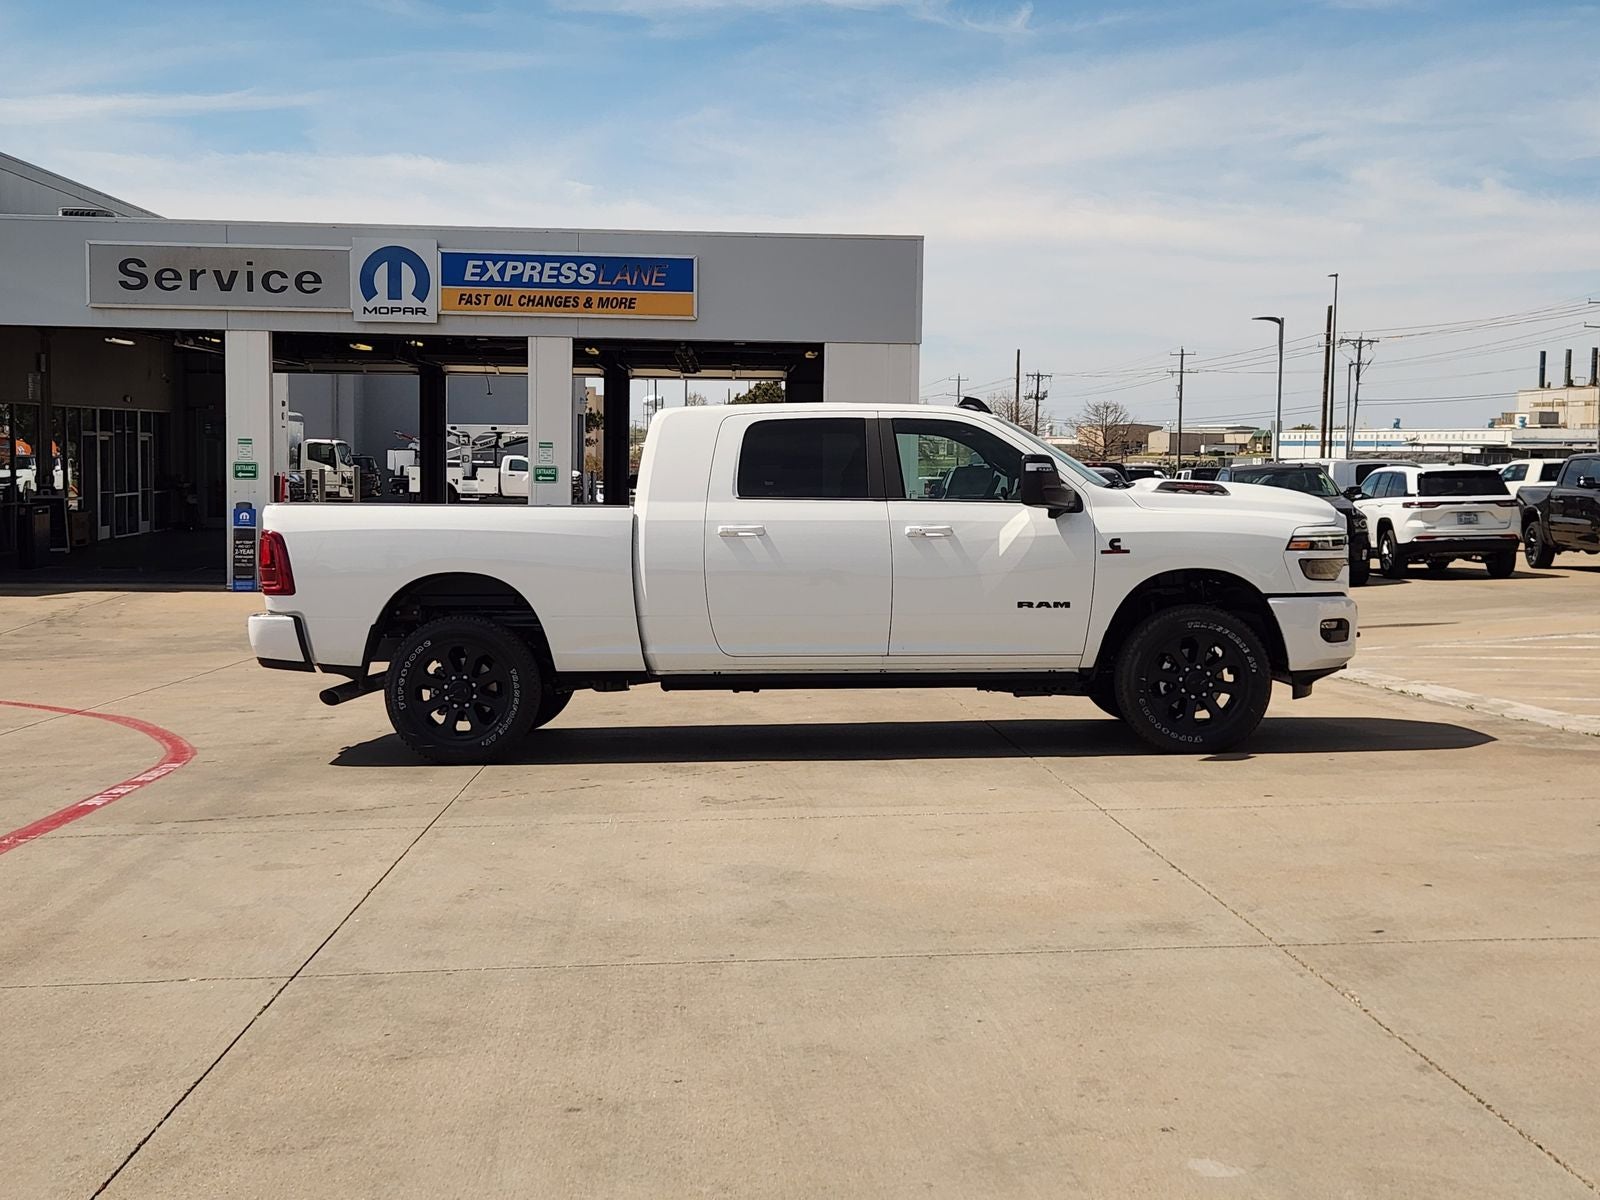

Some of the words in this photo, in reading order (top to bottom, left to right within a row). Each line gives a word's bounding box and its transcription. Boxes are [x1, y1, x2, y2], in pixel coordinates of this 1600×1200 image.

[118, 258, 323, 294] Service
[458, 293, 491, 306] FAST
[494, 294, 514, 307] OIL
[517, 294, 580, 309] CHANGES
[583, 297, 594, 309] &
[597, 297, 637, 310] MORE
[363, 306, 429, 316] MOPAR
